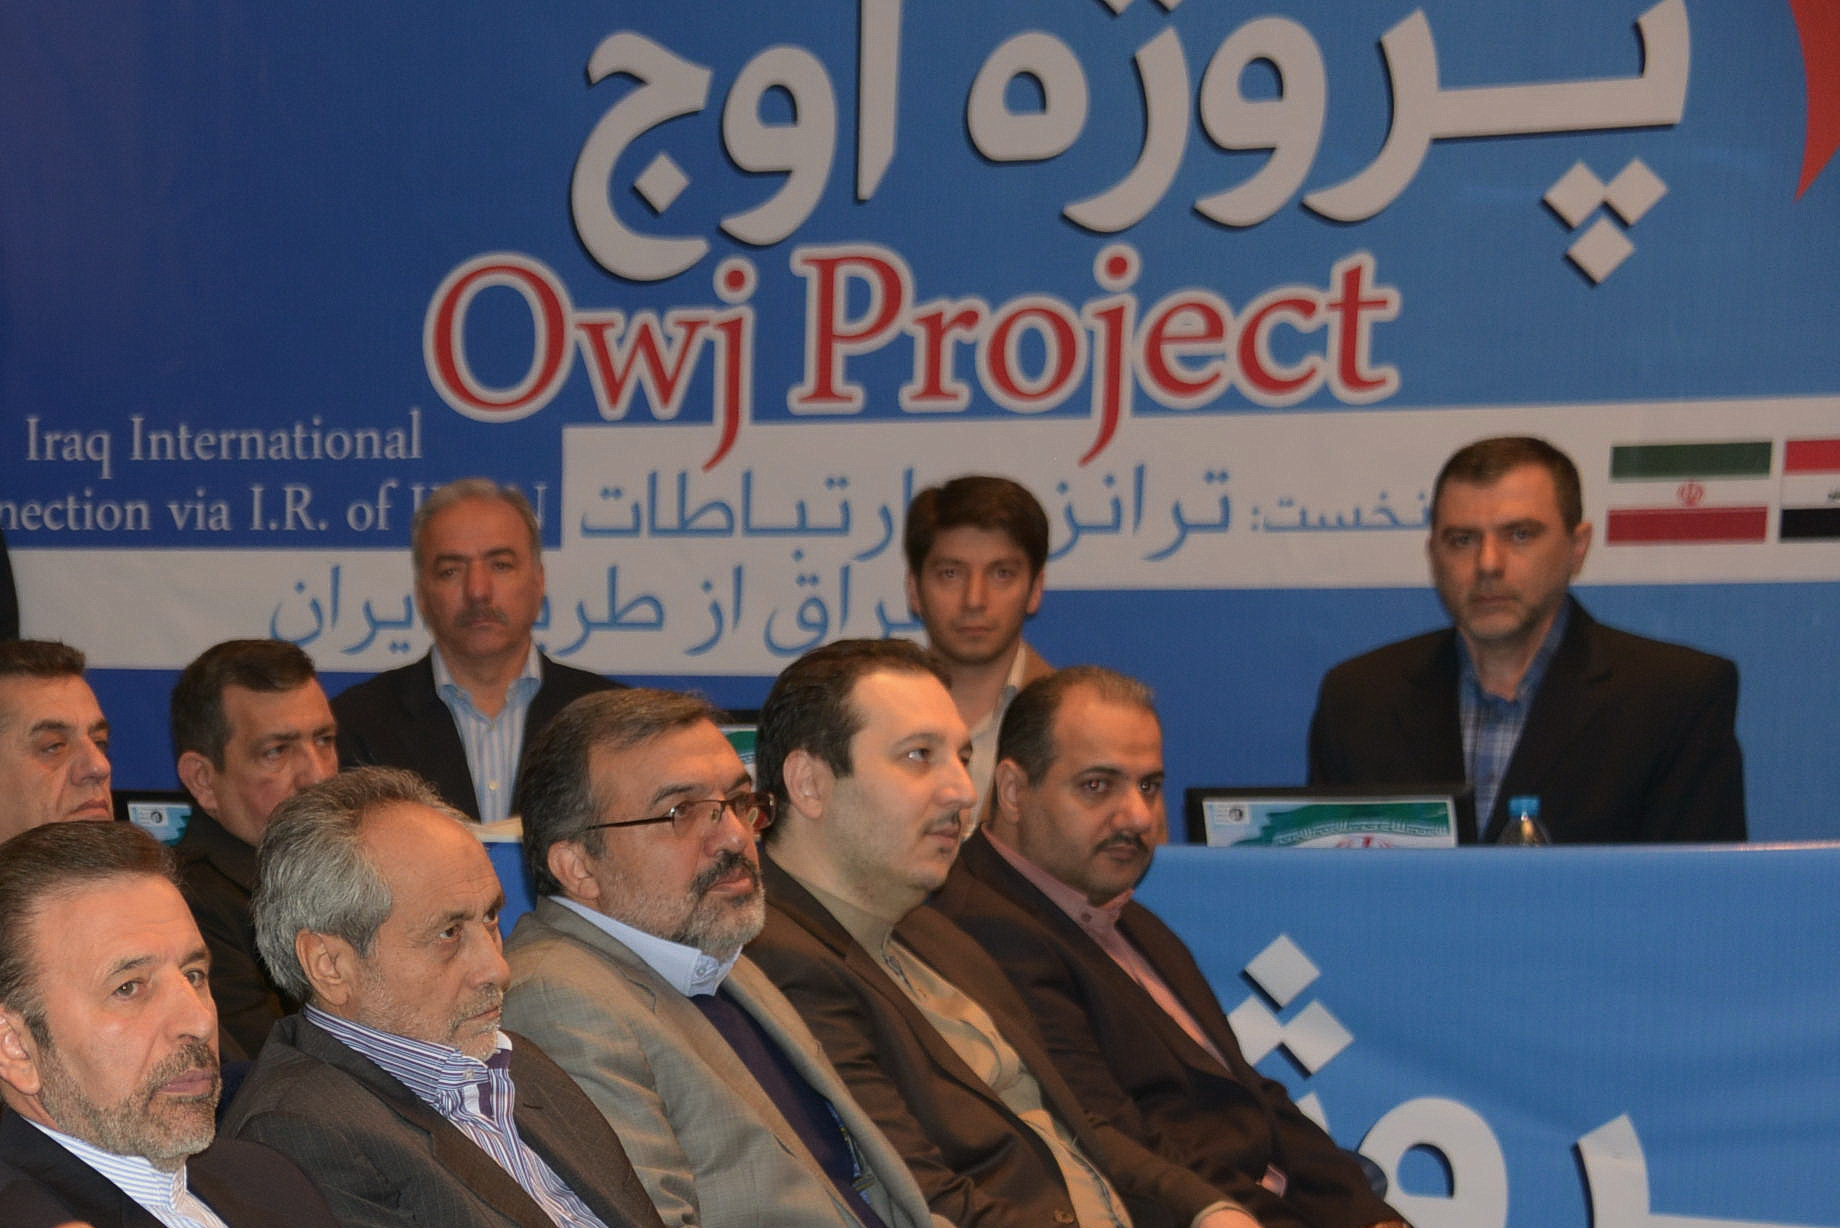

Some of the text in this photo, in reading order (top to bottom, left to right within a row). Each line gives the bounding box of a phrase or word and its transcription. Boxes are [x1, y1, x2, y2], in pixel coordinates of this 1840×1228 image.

[571, 0, 1690, 283] پروژه اوج
[428, 249, 1395, 471] Owj Project
[25, 408, 423, 480] Iraq International
[167, 488, 232, 532] via
[249, 485, 329, 532] I.R.
[346, 479, 399, 532] of
[1047, 465, 1230, 561] ترانز
[270, 563, 925, 656] راق از طر یران
